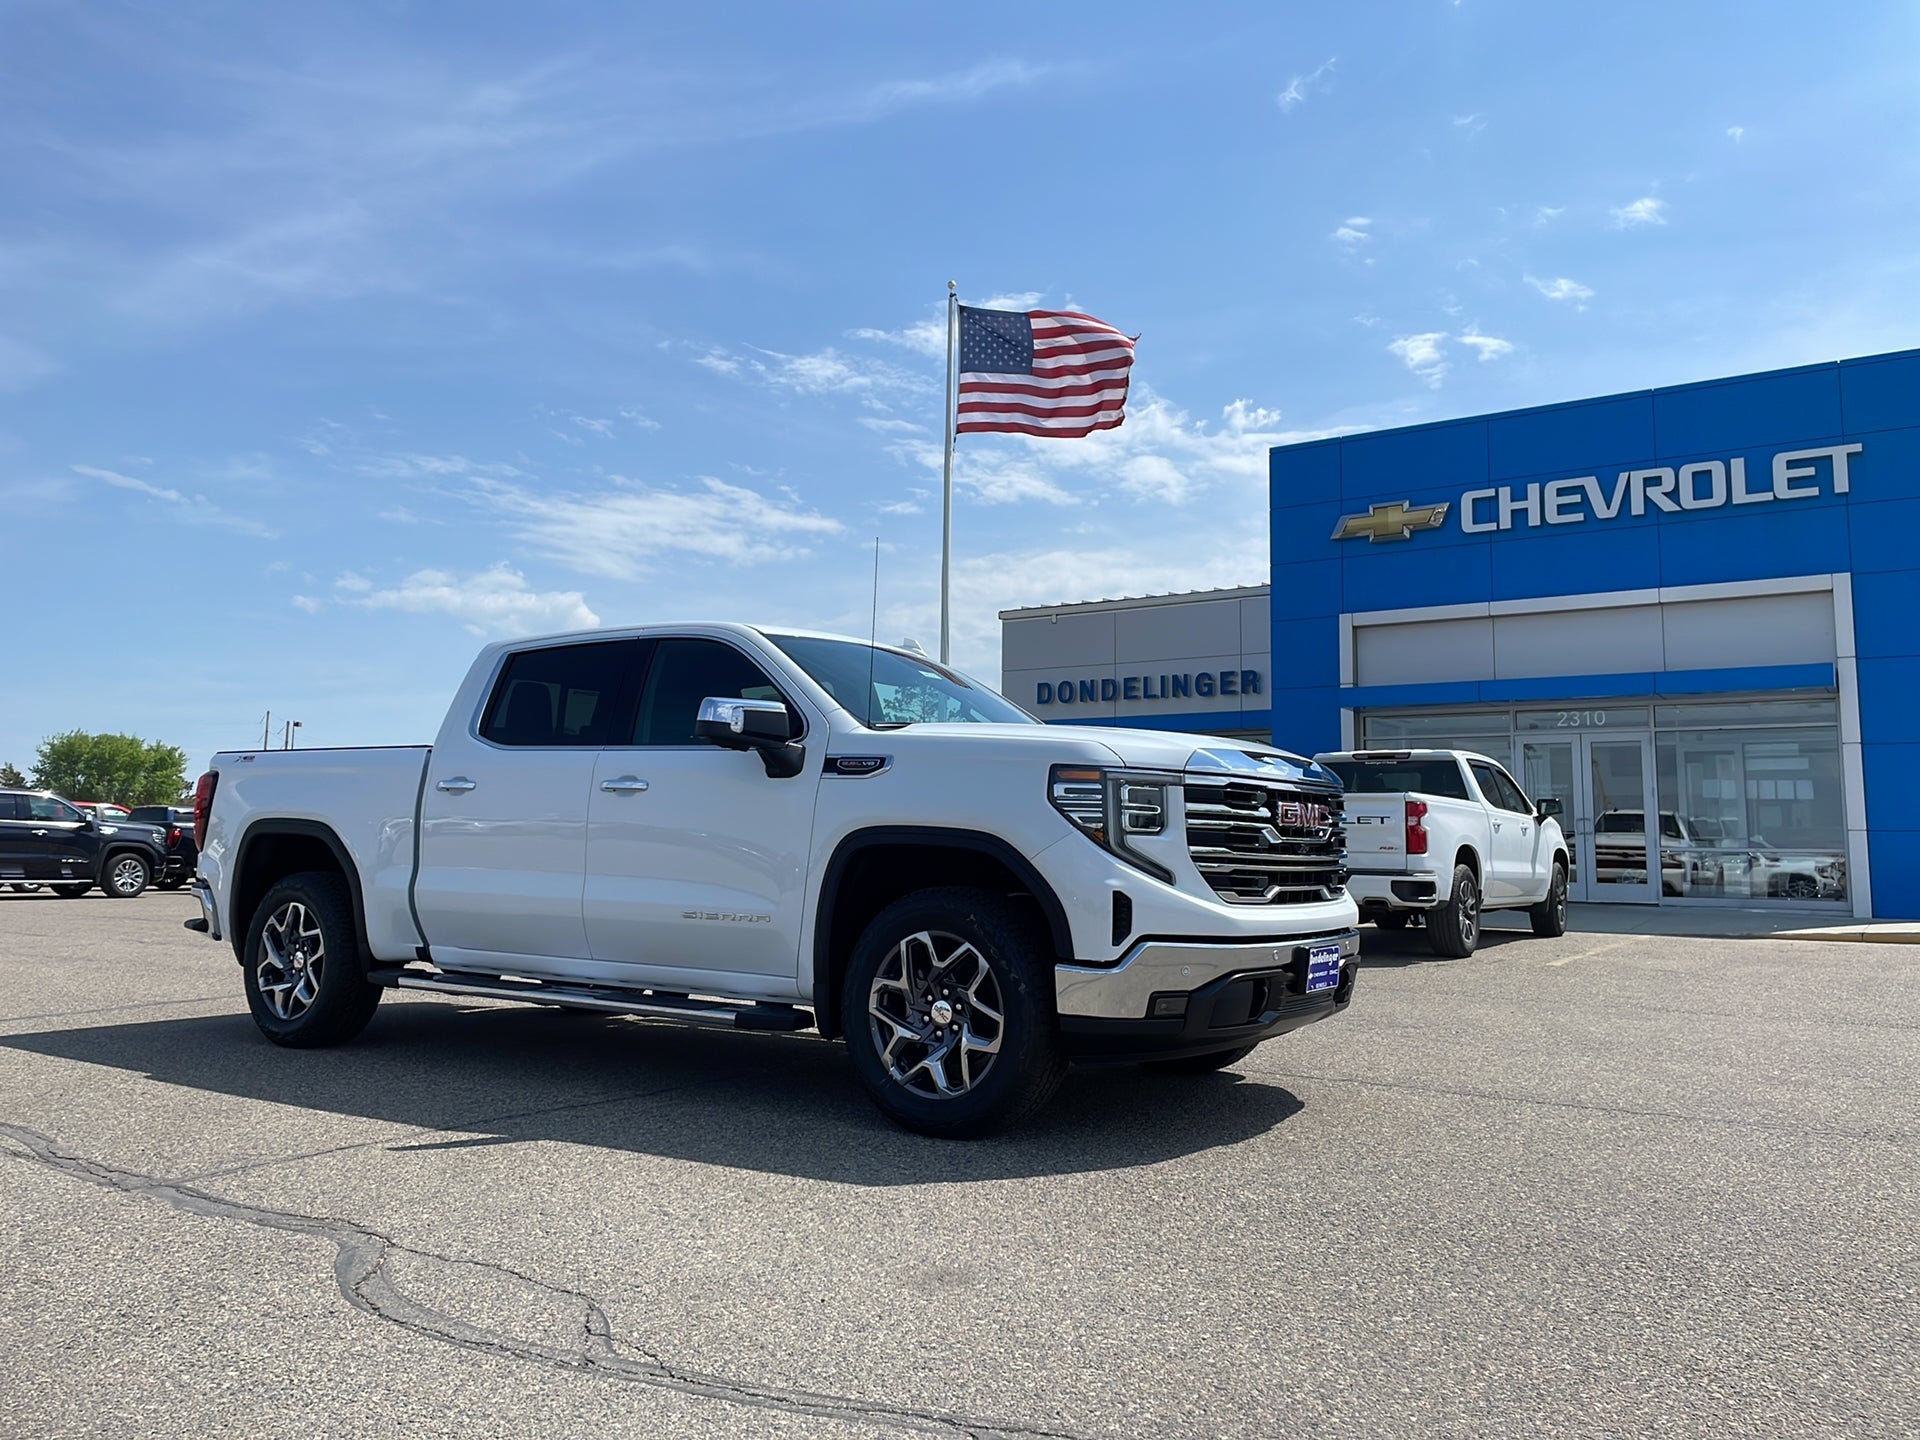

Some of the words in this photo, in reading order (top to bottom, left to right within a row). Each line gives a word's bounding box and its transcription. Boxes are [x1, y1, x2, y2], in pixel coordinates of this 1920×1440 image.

[1460, 443, 1862, 534] CHEVROLET
[1036, 669, 1262, 705] DONDELINGER
[1557, 710, 1606, 727] 2310
[1278, 802, 1330, 828] GMC
[682, 911, 772, 923] SIERRA
